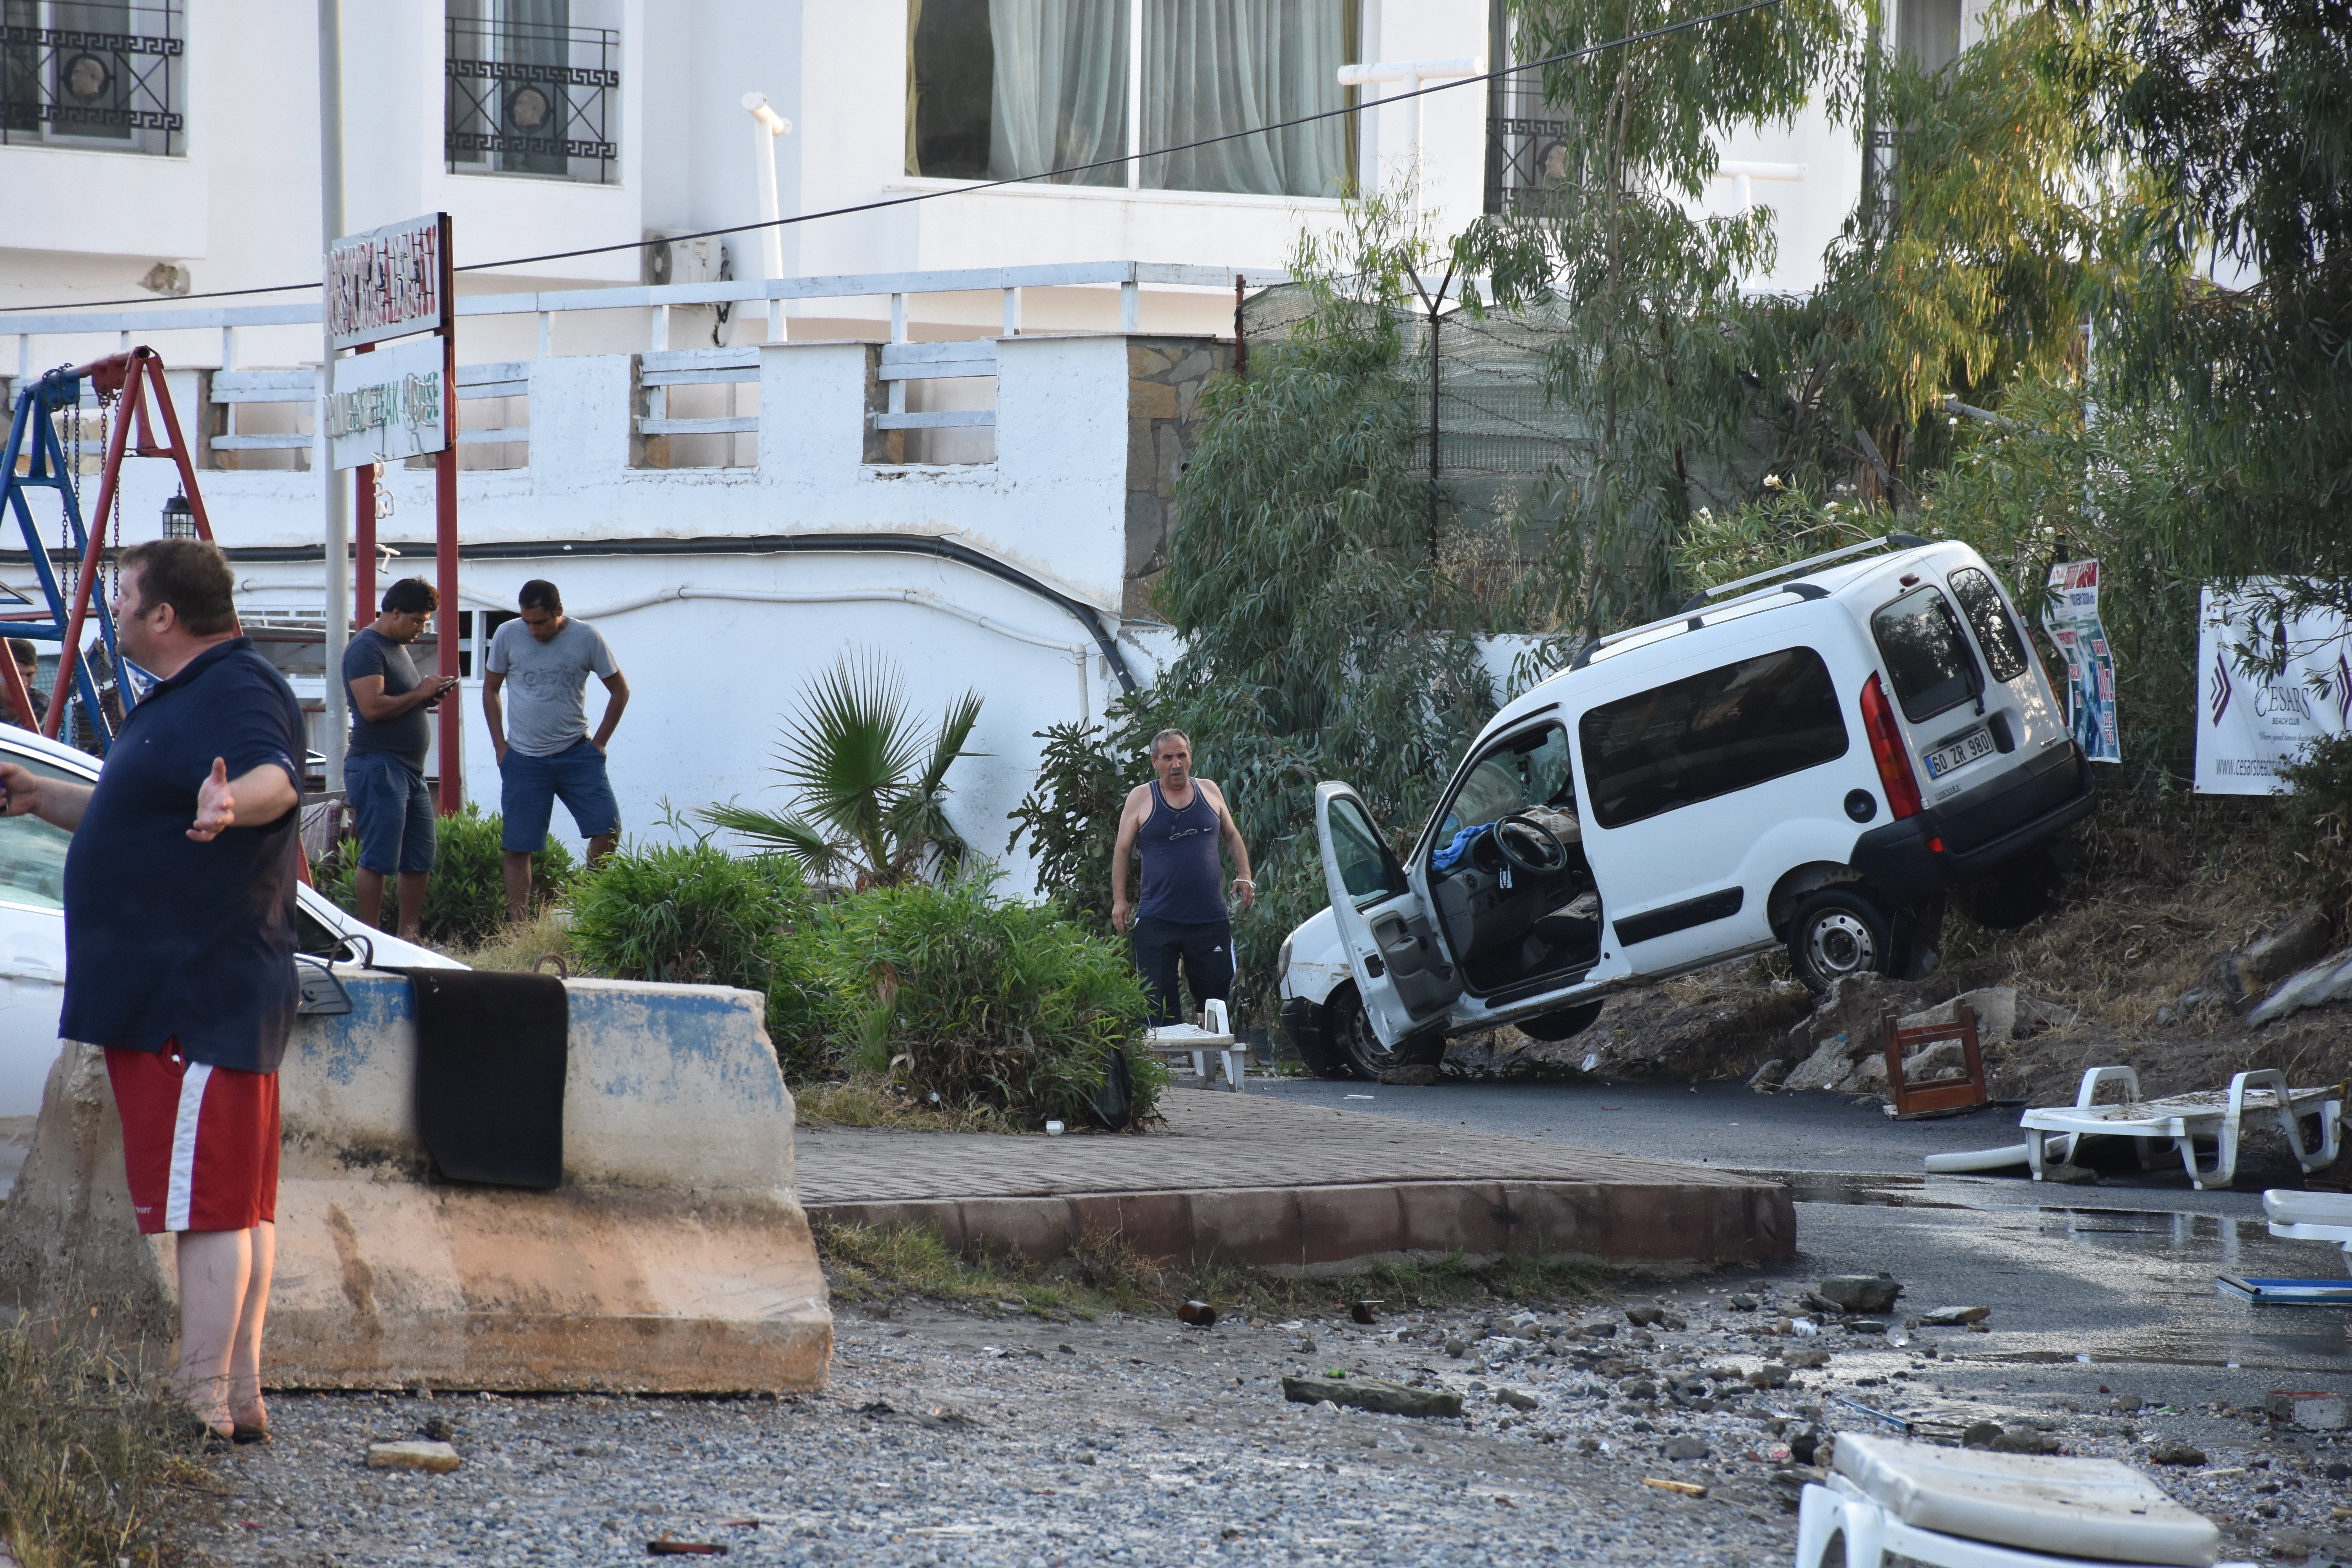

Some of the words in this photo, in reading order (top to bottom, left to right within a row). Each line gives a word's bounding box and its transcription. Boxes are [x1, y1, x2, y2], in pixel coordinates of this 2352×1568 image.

[2255, 686, 2310, 720] CESARS
[1932, 753, 1947, 773] 60
[1949, 745, 1966, 764] ZR
[1968, 734, 1989, 756] 980
